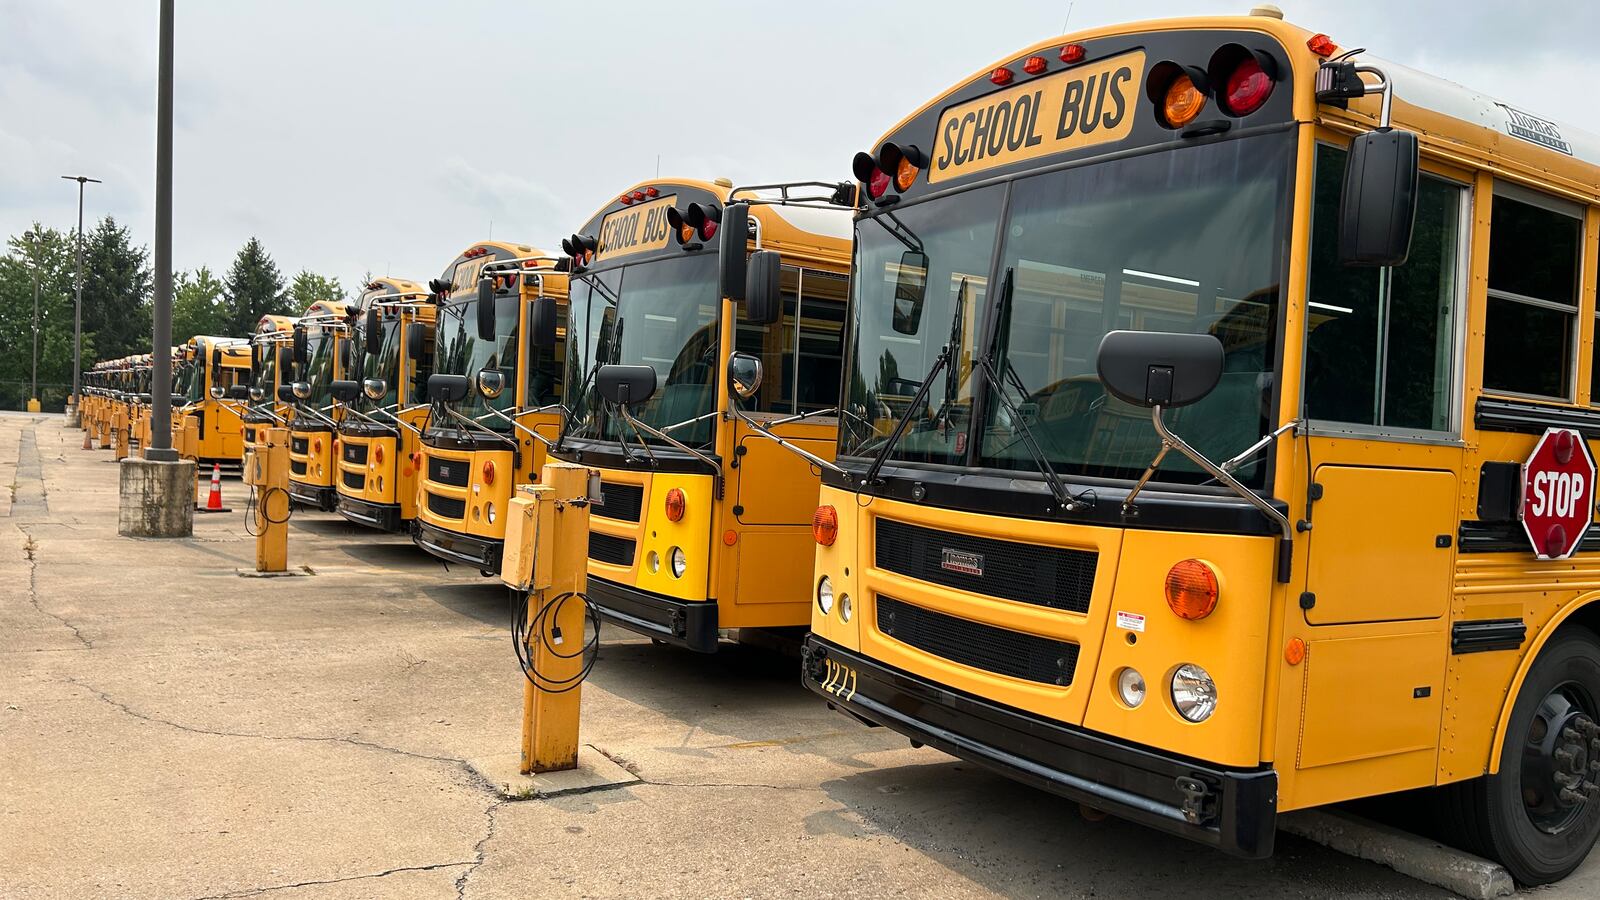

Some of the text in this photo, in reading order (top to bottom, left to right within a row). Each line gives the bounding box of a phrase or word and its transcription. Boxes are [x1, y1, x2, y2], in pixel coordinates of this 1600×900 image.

[938, 67, 1131, 170] SCHOOL BUS
[1512, 126, 1536, 138] BUILT
[600, 204, 670, 253] SCHOOL BUS
[1532, 470, 1584, 518] STOP
[821, 659, 857, 701] 1271
